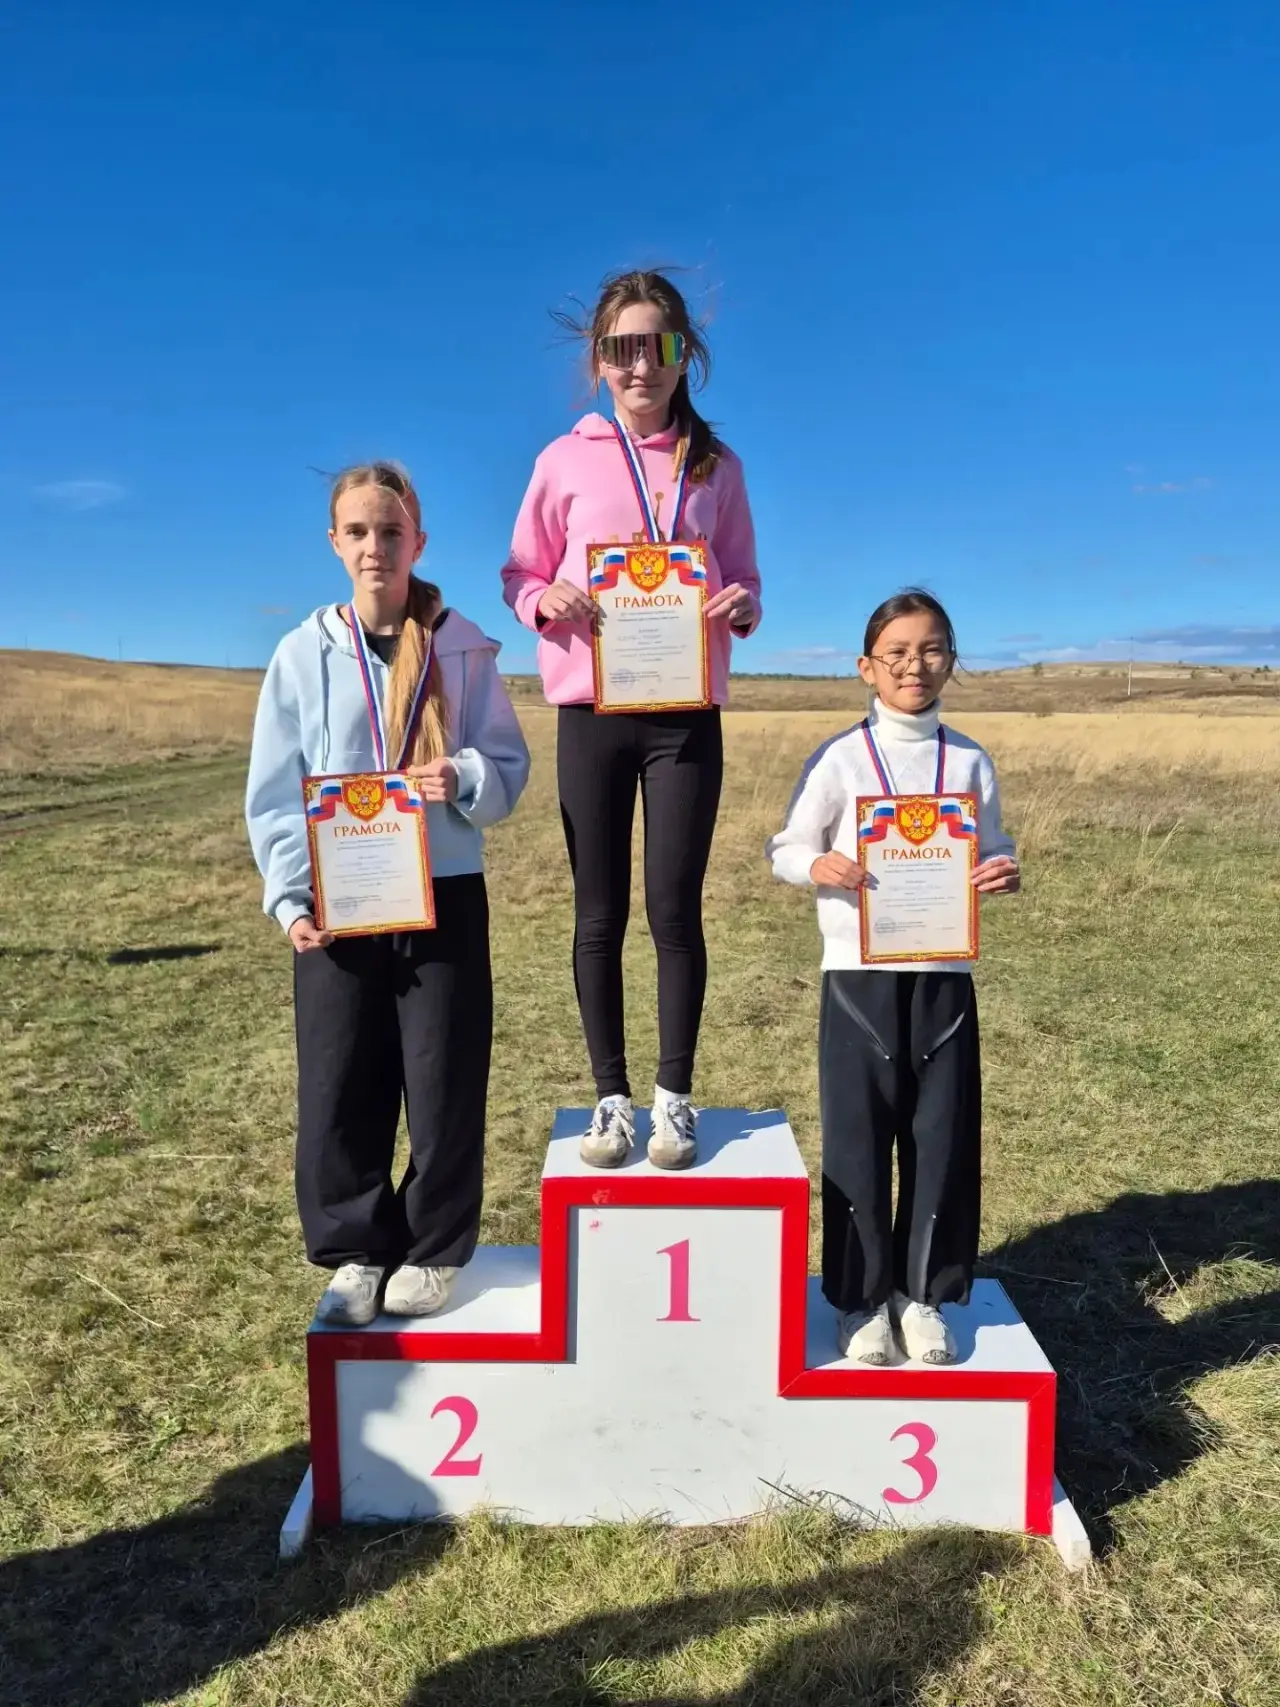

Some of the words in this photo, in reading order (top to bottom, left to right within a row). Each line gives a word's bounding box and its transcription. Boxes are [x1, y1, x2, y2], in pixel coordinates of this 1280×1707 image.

[614, 594, 684, 608] ГРАМОТА
[333, 822, 402, 837] ГРАМОТА
[882, 847, 952, 860] ГРАМОТА
[656, 1239, 700, 1322] 1
[430, 1396, 483, 1477] 2
[882, 1422, 938, 1504] 3
